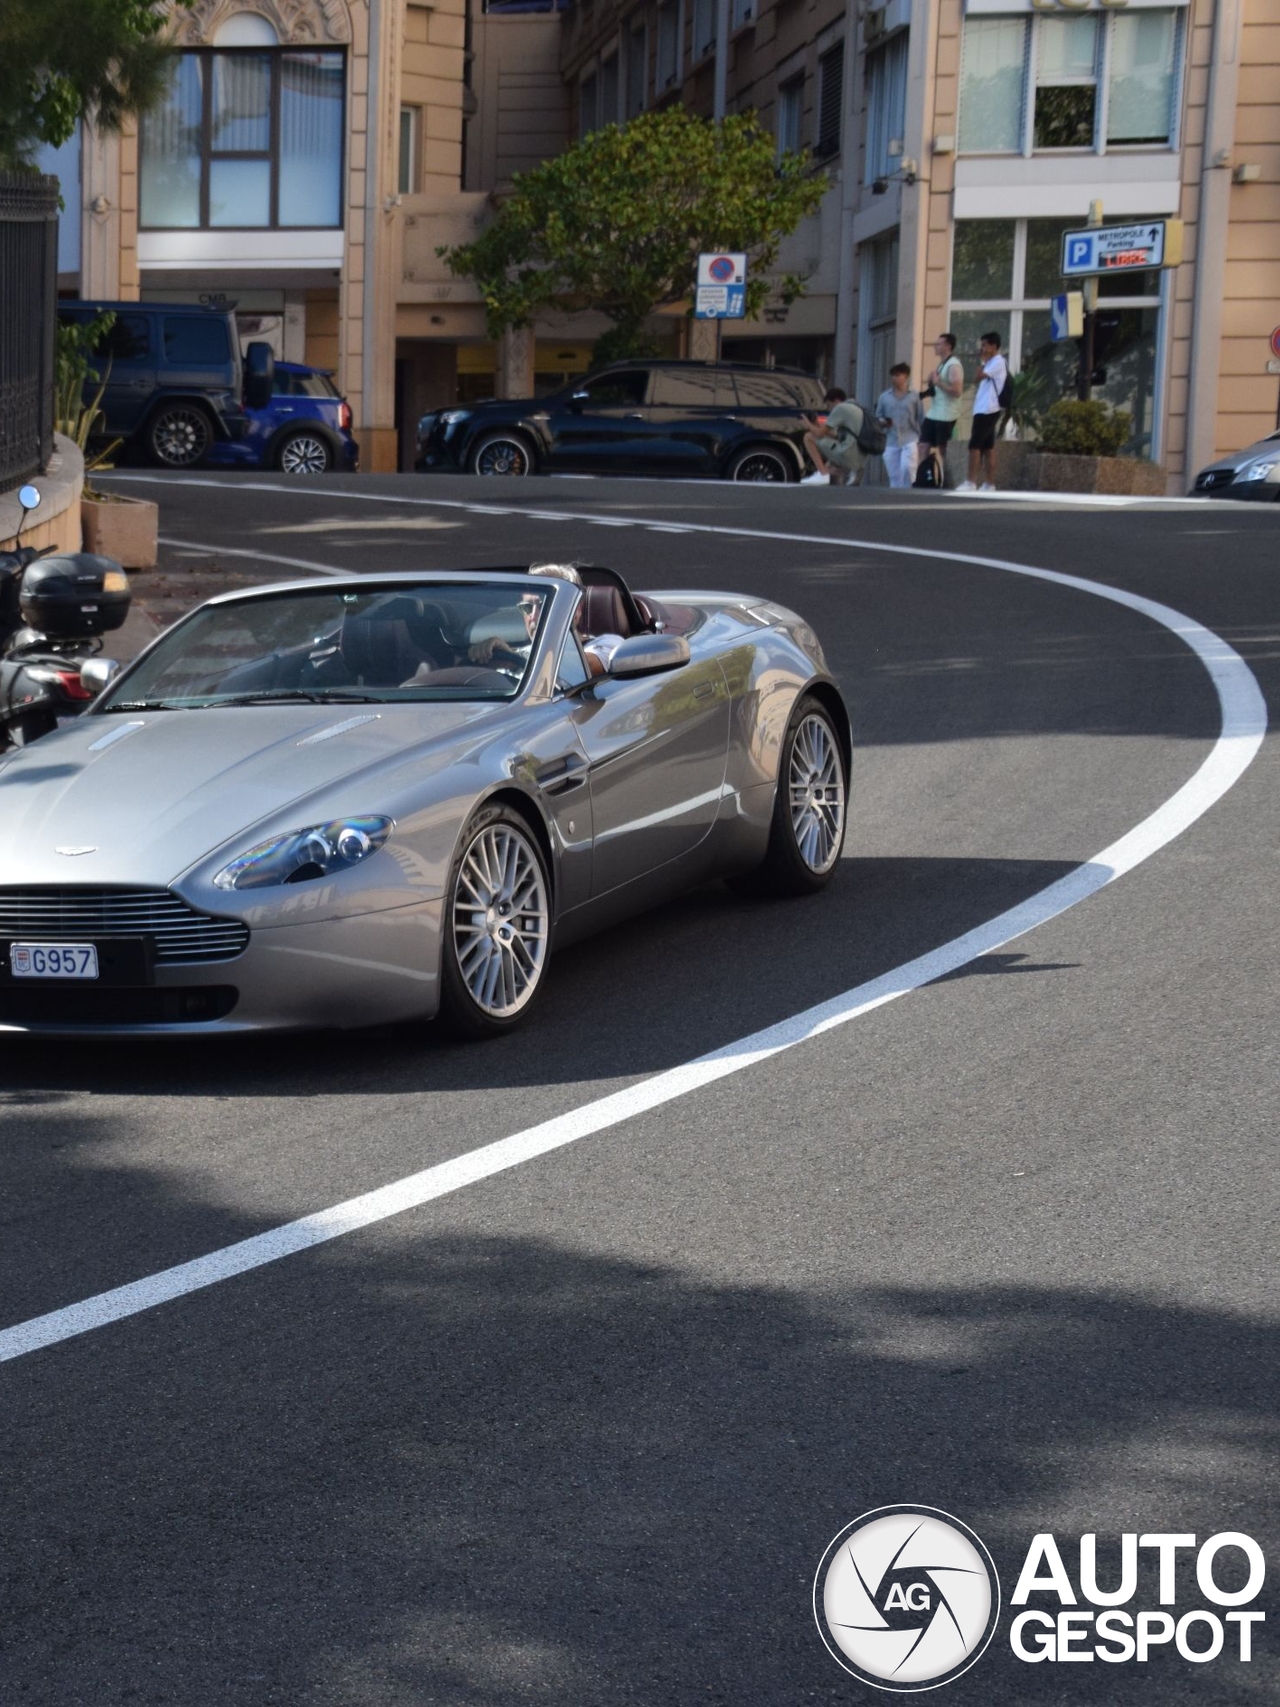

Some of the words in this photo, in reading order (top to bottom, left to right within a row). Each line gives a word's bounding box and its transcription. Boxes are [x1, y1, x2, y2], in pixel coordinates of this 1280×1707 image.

[1098, 229, 1145, 241] METROPOLE
[1073, 242, 1088, 263] P
[1107, 240, 1135, 249] Parking
[33, 949, 91, 974] G957
